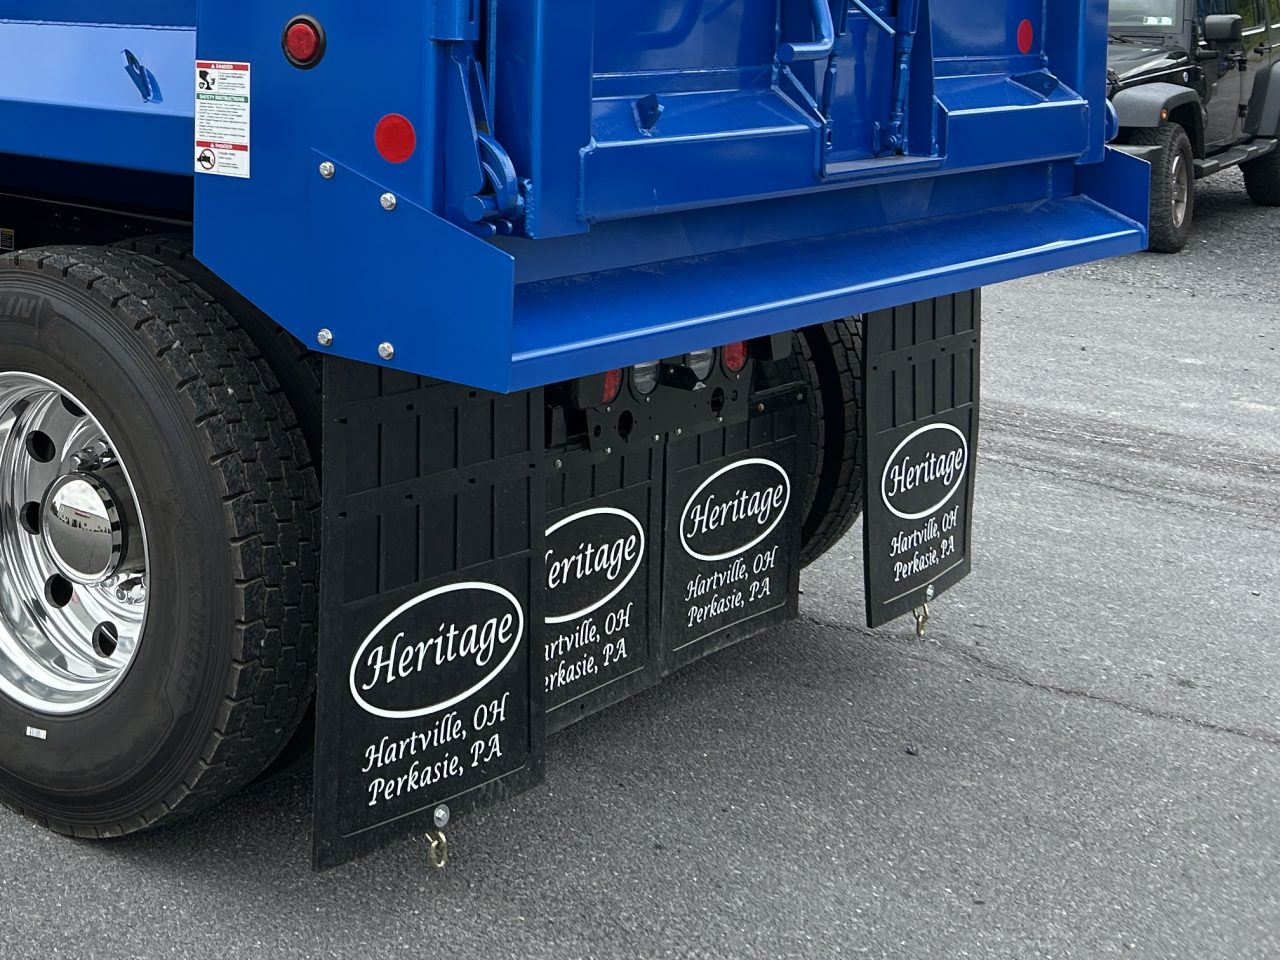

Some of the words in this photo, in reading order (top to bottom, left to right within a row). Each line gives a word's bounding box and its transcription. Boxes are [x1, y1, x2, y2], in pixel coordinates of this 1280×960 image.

[888, 448, 963, 497] Heritage
[687, 485, 784, 539] Heritage
[890, 517, 940, 557] Hartville,
[942, 506, 960, 533] OH
[545, 535, 637, 589] eritage
[685, 558, 749, 602] Hartville,
[753, 546, 779, 574] OH
[894, 547, 939, 582] Perkasie,
[940, 535, 955, 559] PA
[605, 602, 634, 635] OH
[688, 592, 745, 628] Perkasie,
[749, 577, 771, 602] PA
[362, 613, 513, 691] Heritage
[603, 638, 628, 667] PA
[361, 711, 467, 773] Hartville,
[474, 692, 510, 731] OH
[368, 756, 464, 807] Perkasie,
[471, 734, 503, 768] PA
